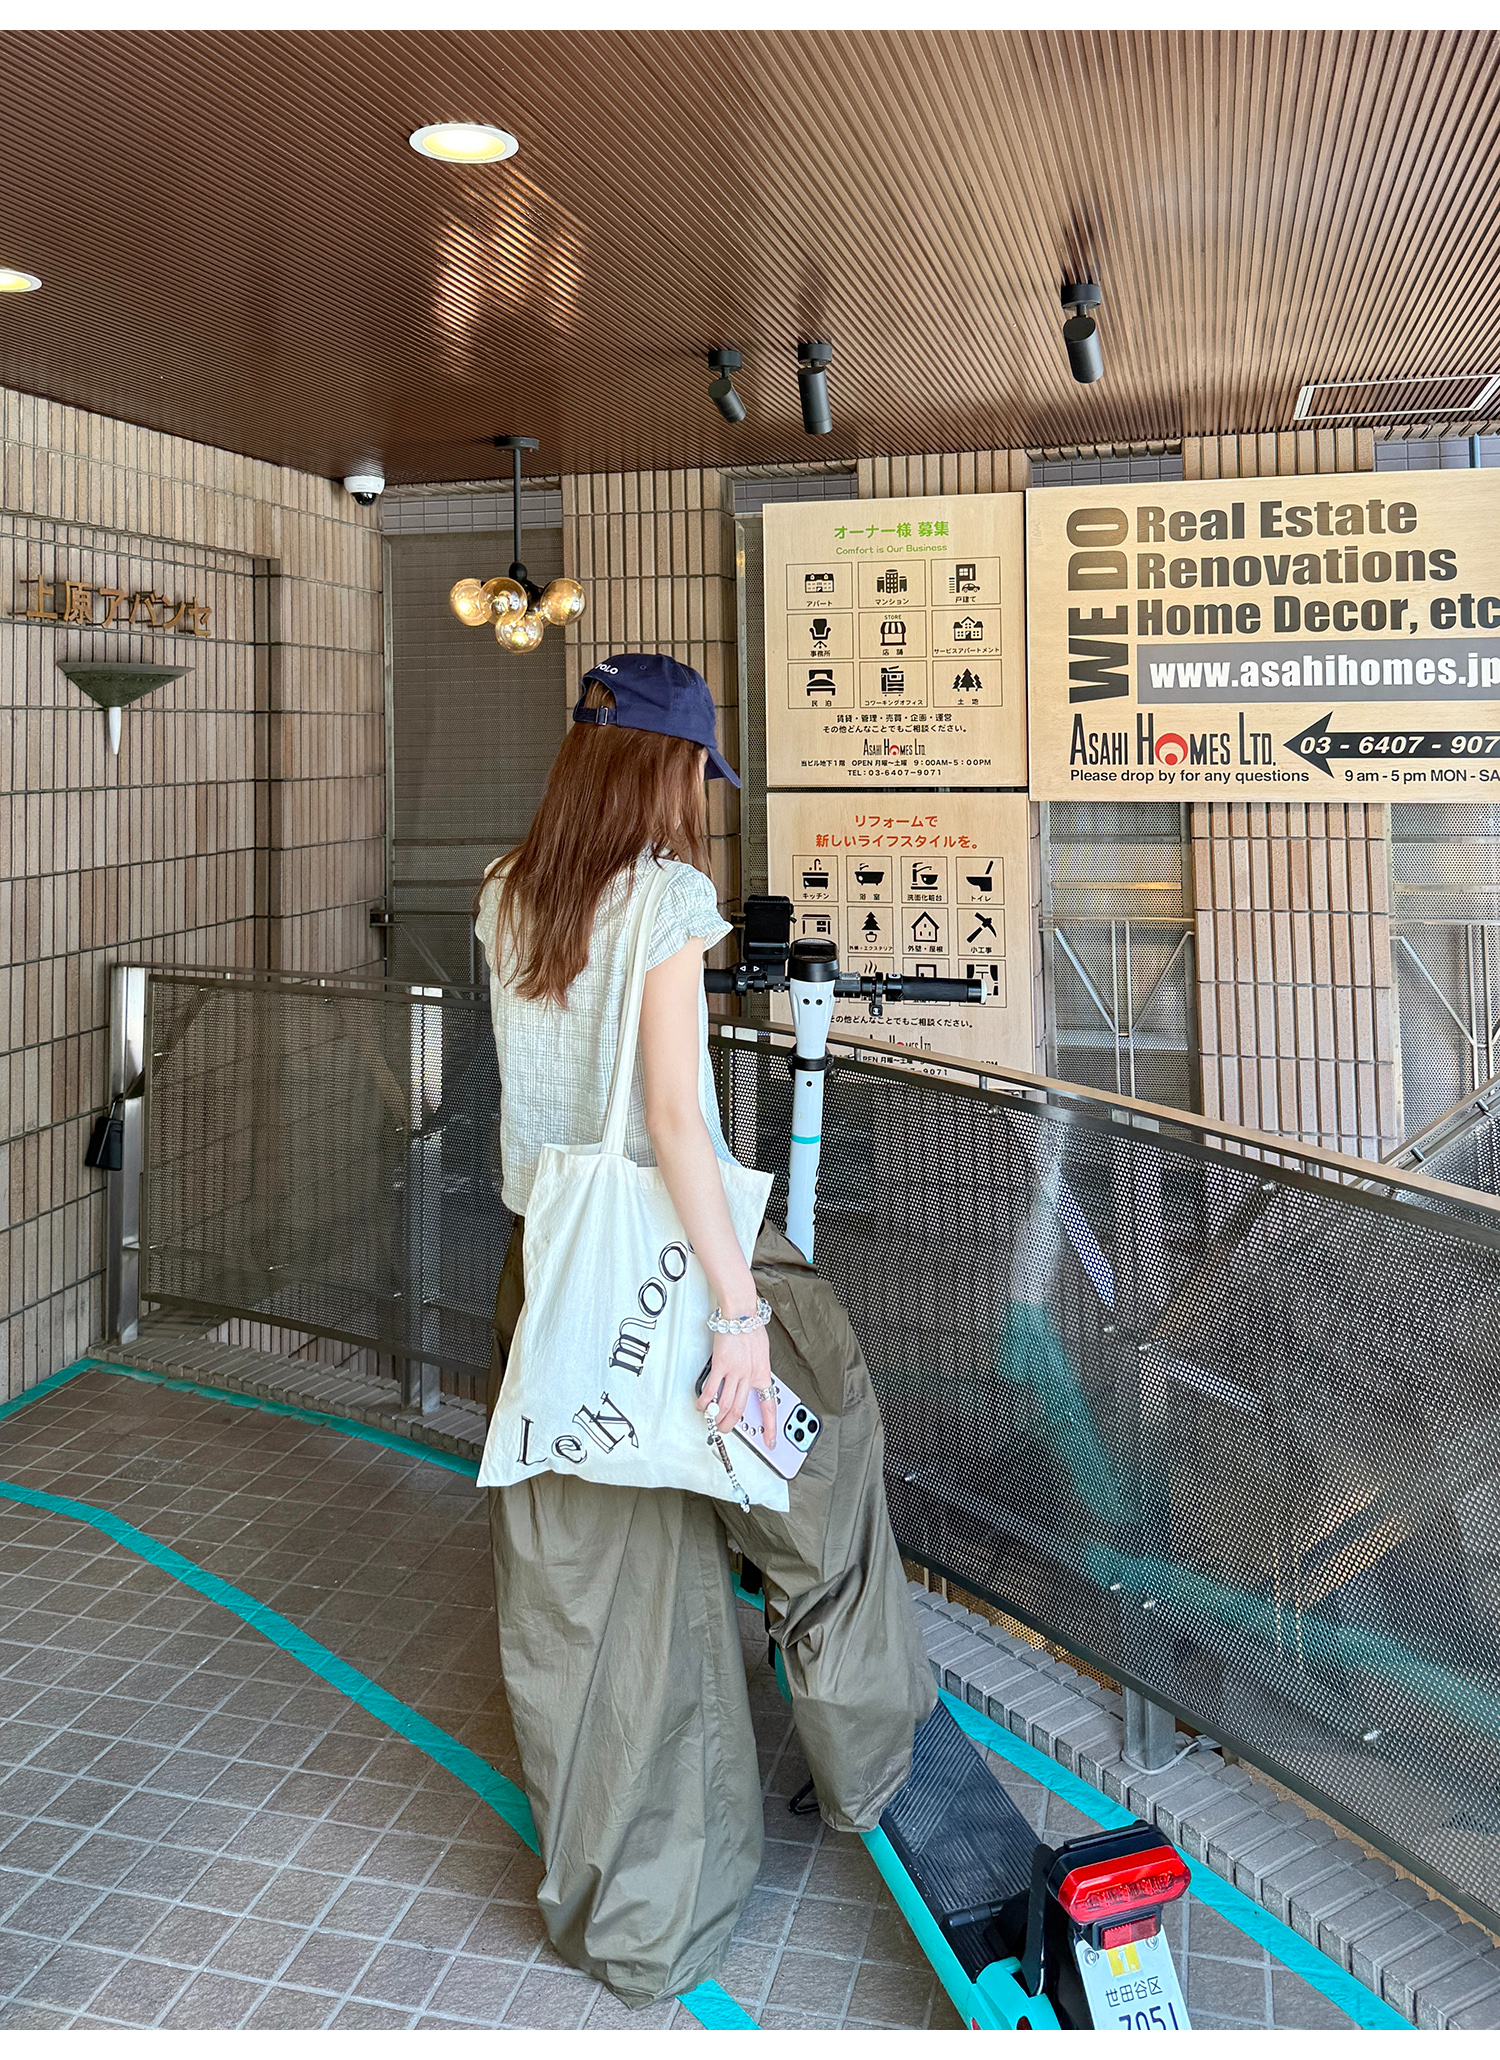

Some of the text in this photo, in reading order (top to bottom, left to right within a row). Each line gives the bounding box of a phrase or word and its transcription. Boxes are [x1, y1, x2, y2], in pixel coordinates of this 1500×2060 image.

[834, 520, 949, 540] オーナー様 募集
[1137, 499, 1418, 543] Real Estate
[836, 543, 948, 555] Comfort is Our Business
[1137, 545, 1459, 590] Renovations
[26, 574, 213, 637] 上原アバンセ
[806, 600, 833, 608] アパート
[875, 598, 910, 606] マンション
[955, 596, 977, 604] 戸建て
[1066, 507, 1129, 704] WE DO
[1137, 599, 1261, 636] Home
[1273, 595, 1417, 635] Decor,
[1149, 652, 1500, 688] www.asahihomes.jp
[822, 724, 967, 734] その他どんなことでもご相談ください。
[1069, 712, 1128, 766] ASAHI
[1239, 711, 1277, 767] LTD.
[1300, 735, 1332, 755] 03
[1358, 735, 1425, 755] 6407
[1070, 768, 1310, 785] Please drop by for any questions
[1344, 770, 1353, 782] 9
[1356, 772, 1379, 782] am
[1391, 770, 1400, 782] 5
[1403, 772, 1427, 785] pm
[1430, 769, 1467, 782] MON
[855, 815, 938, 828] リフォームで
[815, 833, 979, 849] 新しいライフスタイルを。
[802, 892, 830, 900] キッチン
[970, 946, 992, 954] 小工事
[609, 1240, 697, 1377] moo
[1105, 1976, 1163, 2008] 世田谷区
